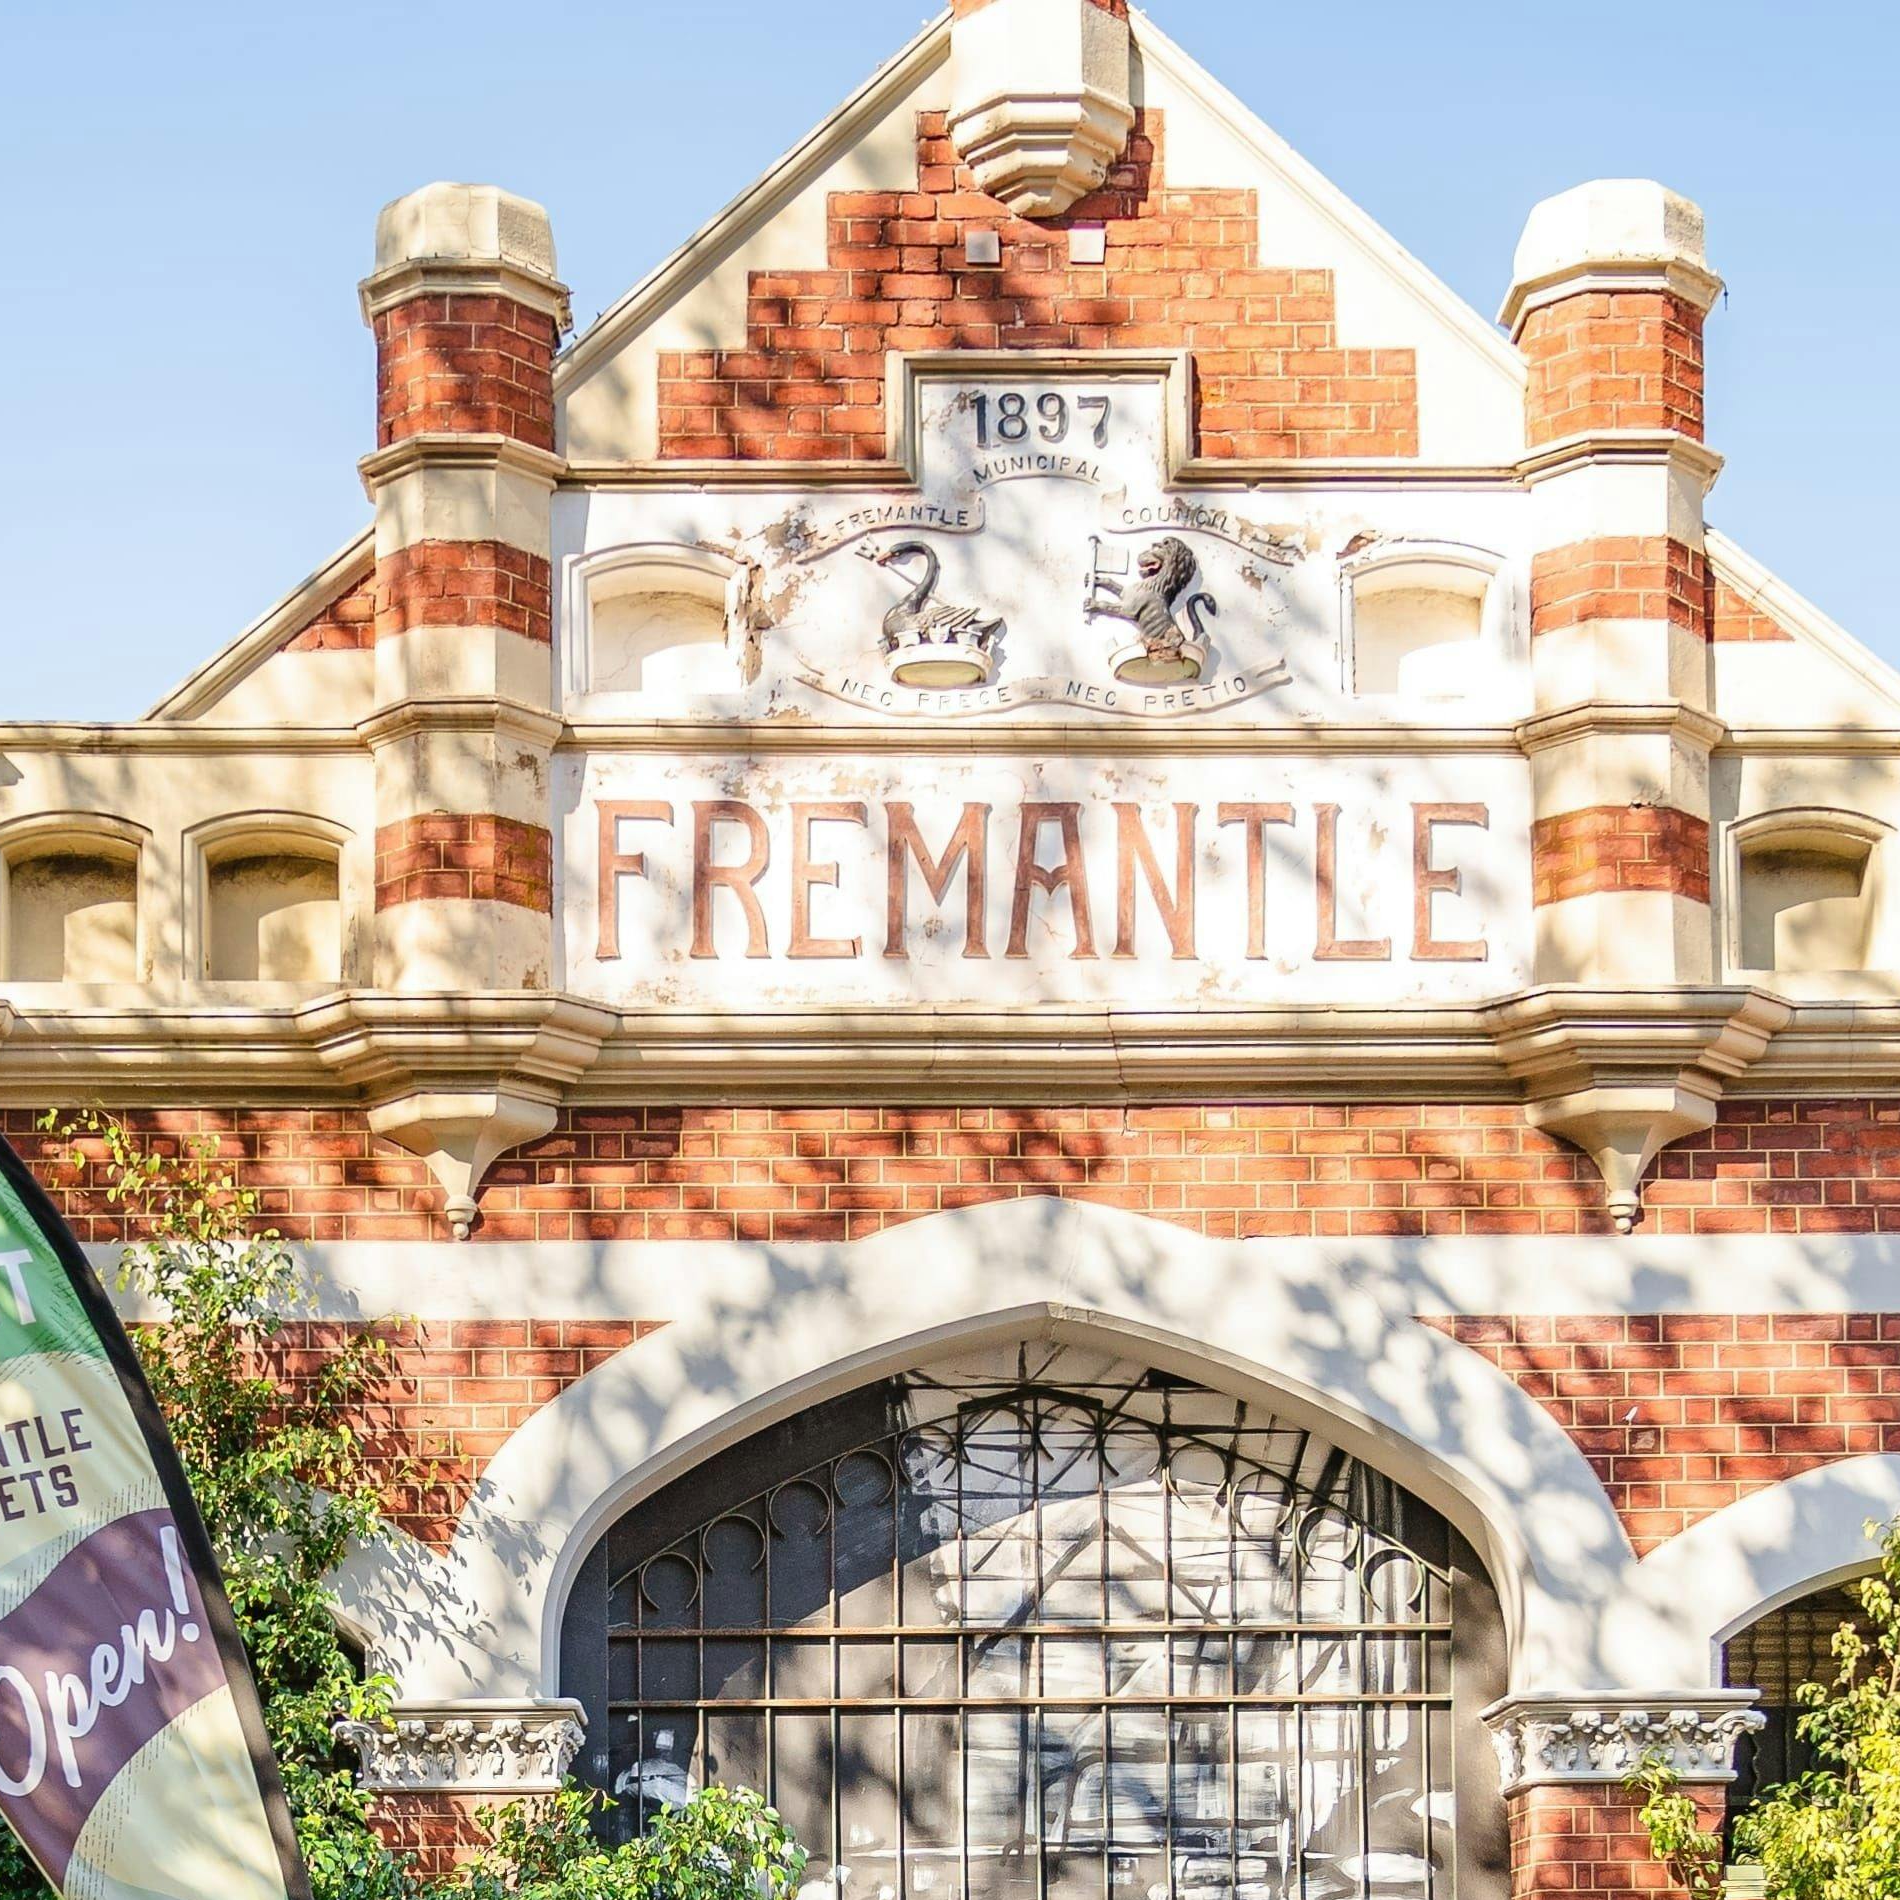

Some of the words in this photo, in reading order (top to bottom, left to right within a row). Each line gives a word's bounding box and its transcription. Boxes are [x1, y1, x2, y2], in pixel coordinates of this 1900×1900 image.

[969, 391, 1111, 451] 1897
[972, 455, 1102, 486] MUNICIPAL
[835, 505, 970, 538] FREMANTLE
[1122, 508, 1232, 535] COUNCIL
[840, 678, 894, 708] NEC
[1065, 680, 1118, 709] NEC
[1144, 676, 1248, 711] PRETIO
[595, 801, 1491, 962] FREMANTLE
